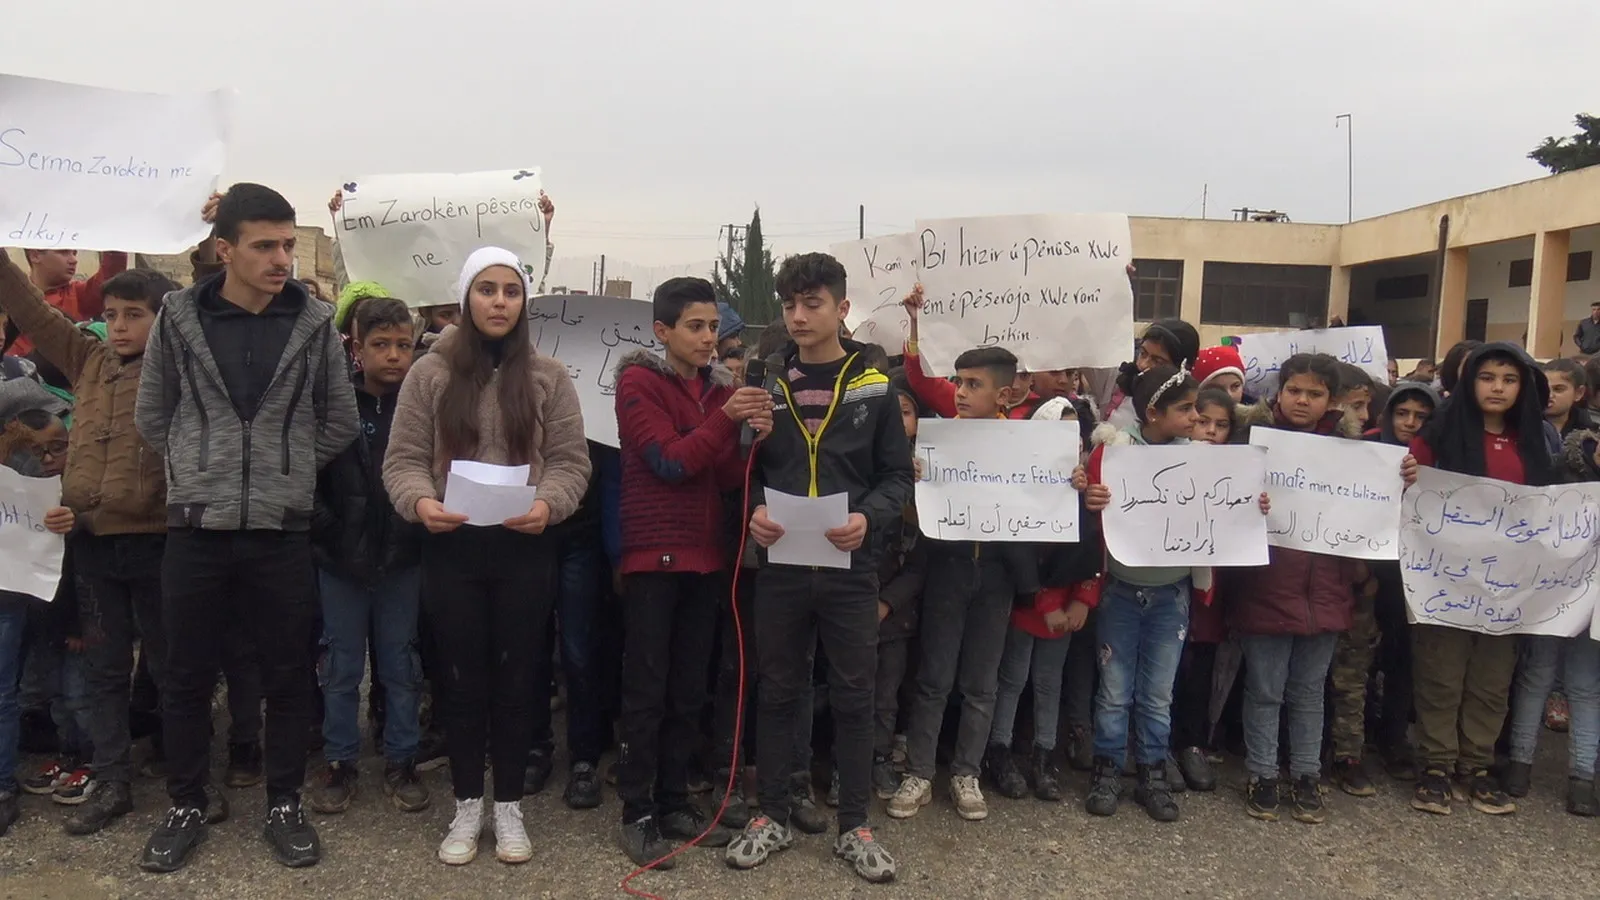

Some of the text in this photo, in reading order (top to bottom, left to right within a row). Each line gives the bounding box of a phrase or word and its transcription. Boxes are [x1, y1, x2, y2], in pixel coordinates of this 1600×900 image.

[0, 127, 82, 173] Serma
[170, 166, 192, 178] me
[342, 197, 375, 231] Em
[379, 197, 469, 226] Zarokên
[920, 228, 946, 269] Bi
[959, 226, 1003, 266] hizir
[923, 299, 944, 315] em
[1176, 477, 1196, 505] لن
[23, 509, 46, 533] to
[980, 502, 1002, 533] أن
[1050, 519, 1073, 534] من
[1426, 502, 1503, 534] المستقبل
[1367, 538, 1390, 551] من
